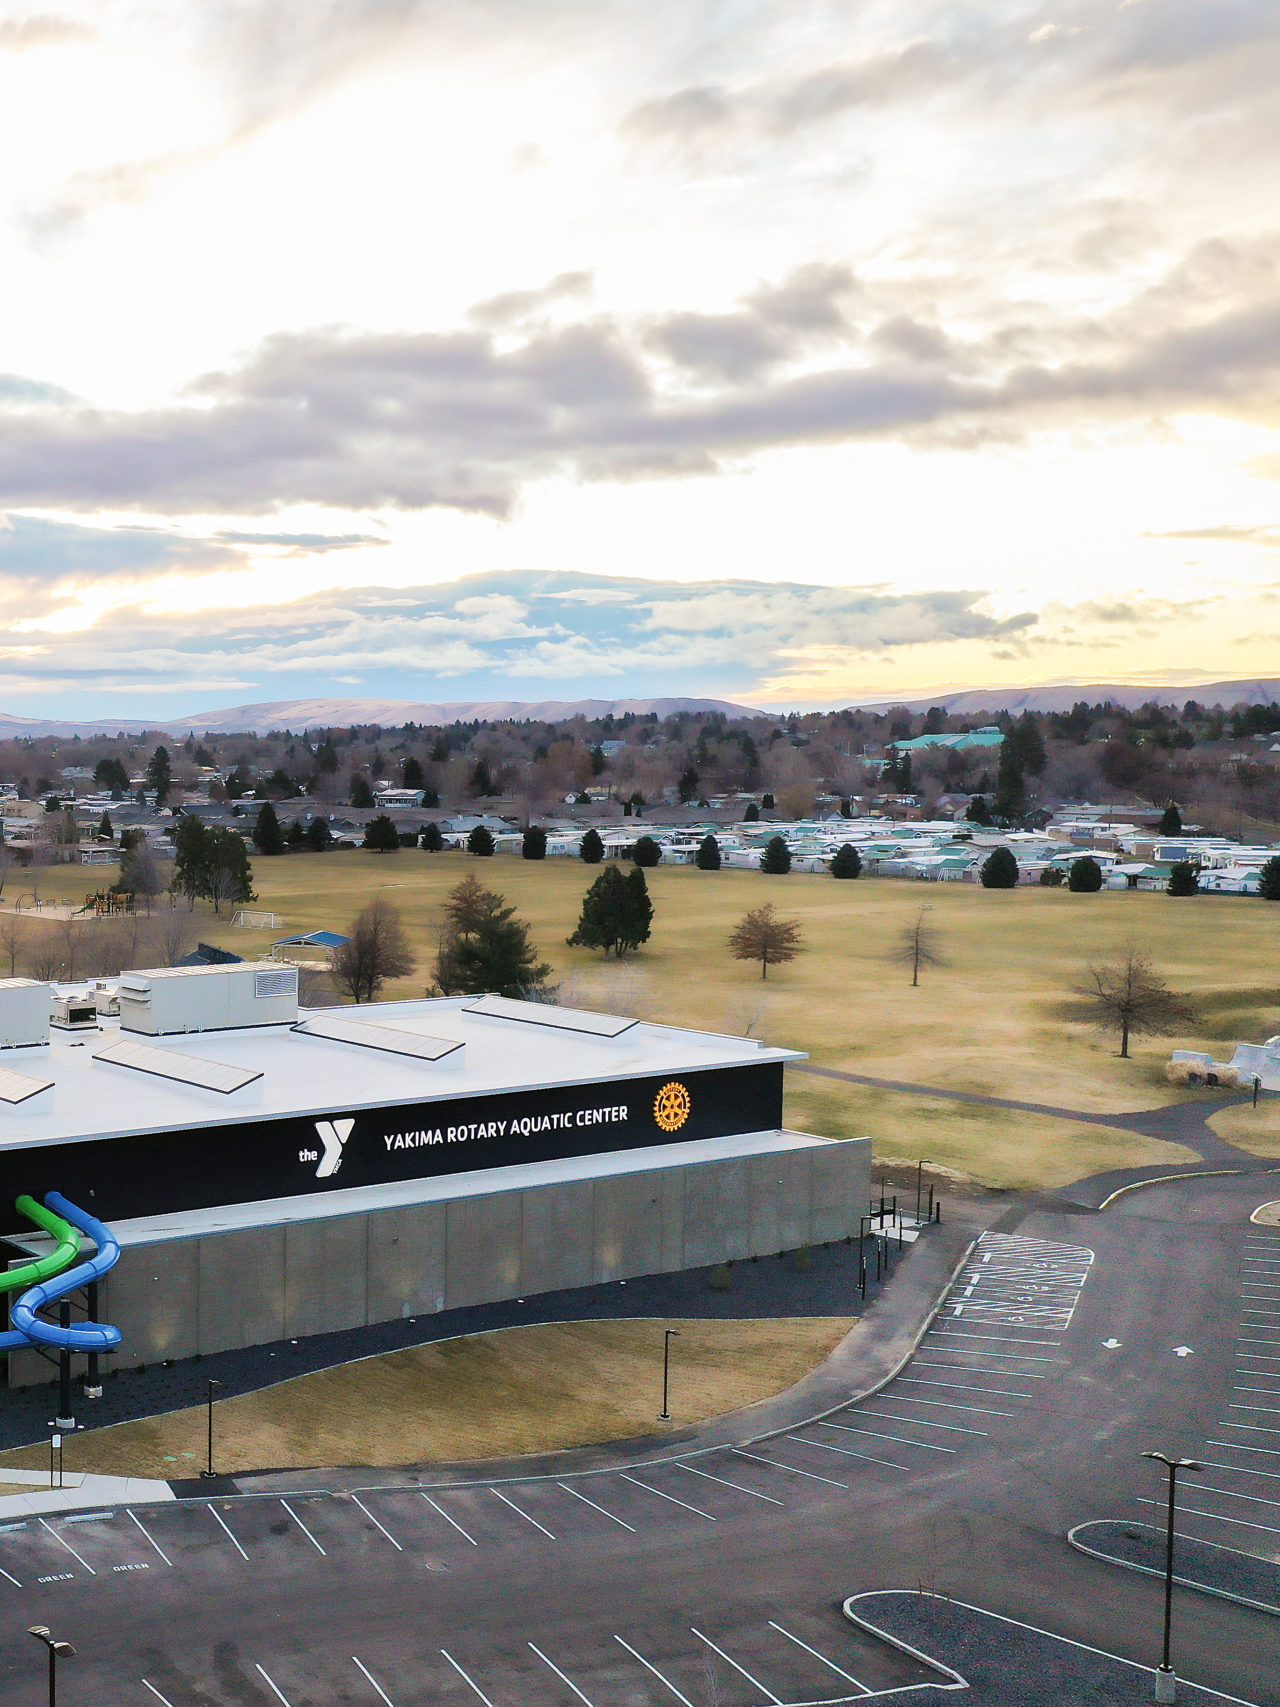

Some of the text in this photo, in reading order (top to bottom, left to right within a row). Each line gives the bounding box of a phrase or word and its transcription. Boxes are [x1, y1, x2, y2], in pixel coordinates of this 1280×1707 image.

[384, 1105, 628, 1151] YAKIMA ROTARY AQUATIC CENTER
[298, 1148, 318, 1162] the
[112, 1563, 150, 1572] GREEN
[37, 1572, 75, 1584] GREEN
